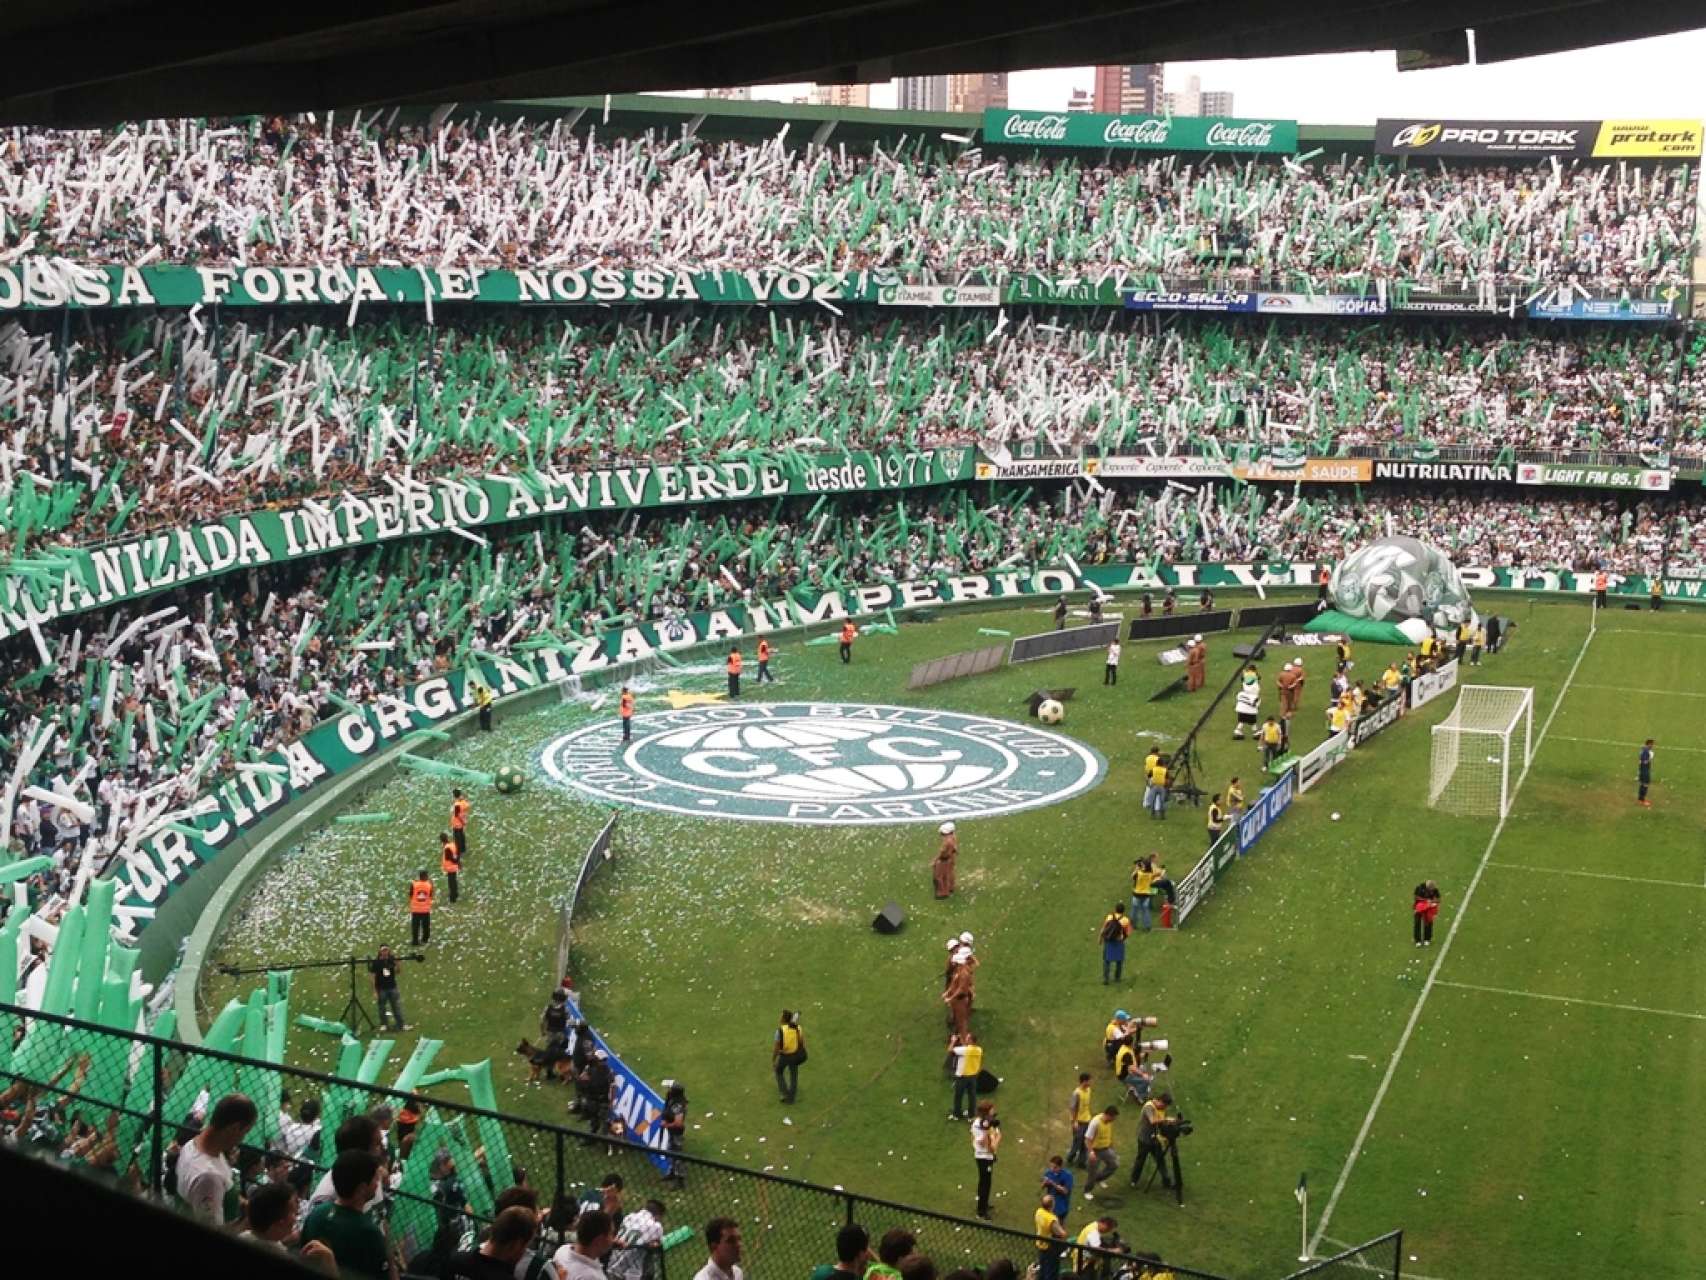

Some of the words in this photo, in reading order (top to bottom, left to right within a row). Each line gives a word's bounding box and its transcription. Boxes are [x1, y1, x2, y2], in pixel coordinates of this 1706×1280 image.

[1440, 129, 1499, 143] PRO
[1503, 129, 1579, 144] TORK
[1609, 131, 1696, 146] protork
[515, 268, 699, 300] NOSSA
[1582, 301, 1619, 313] NET
[1375, 462, 1512, 481] NUTRILATINA
[1585, 471, 1608, 485] FM
[506, 461, 789, 518] ALVIVERDE
[805, 457, 866, 491] desde
[875, 450, 934, 488] 1977
[808, 705, 941, 727] BALL
[962, 723, 1071, 759] CLUB
